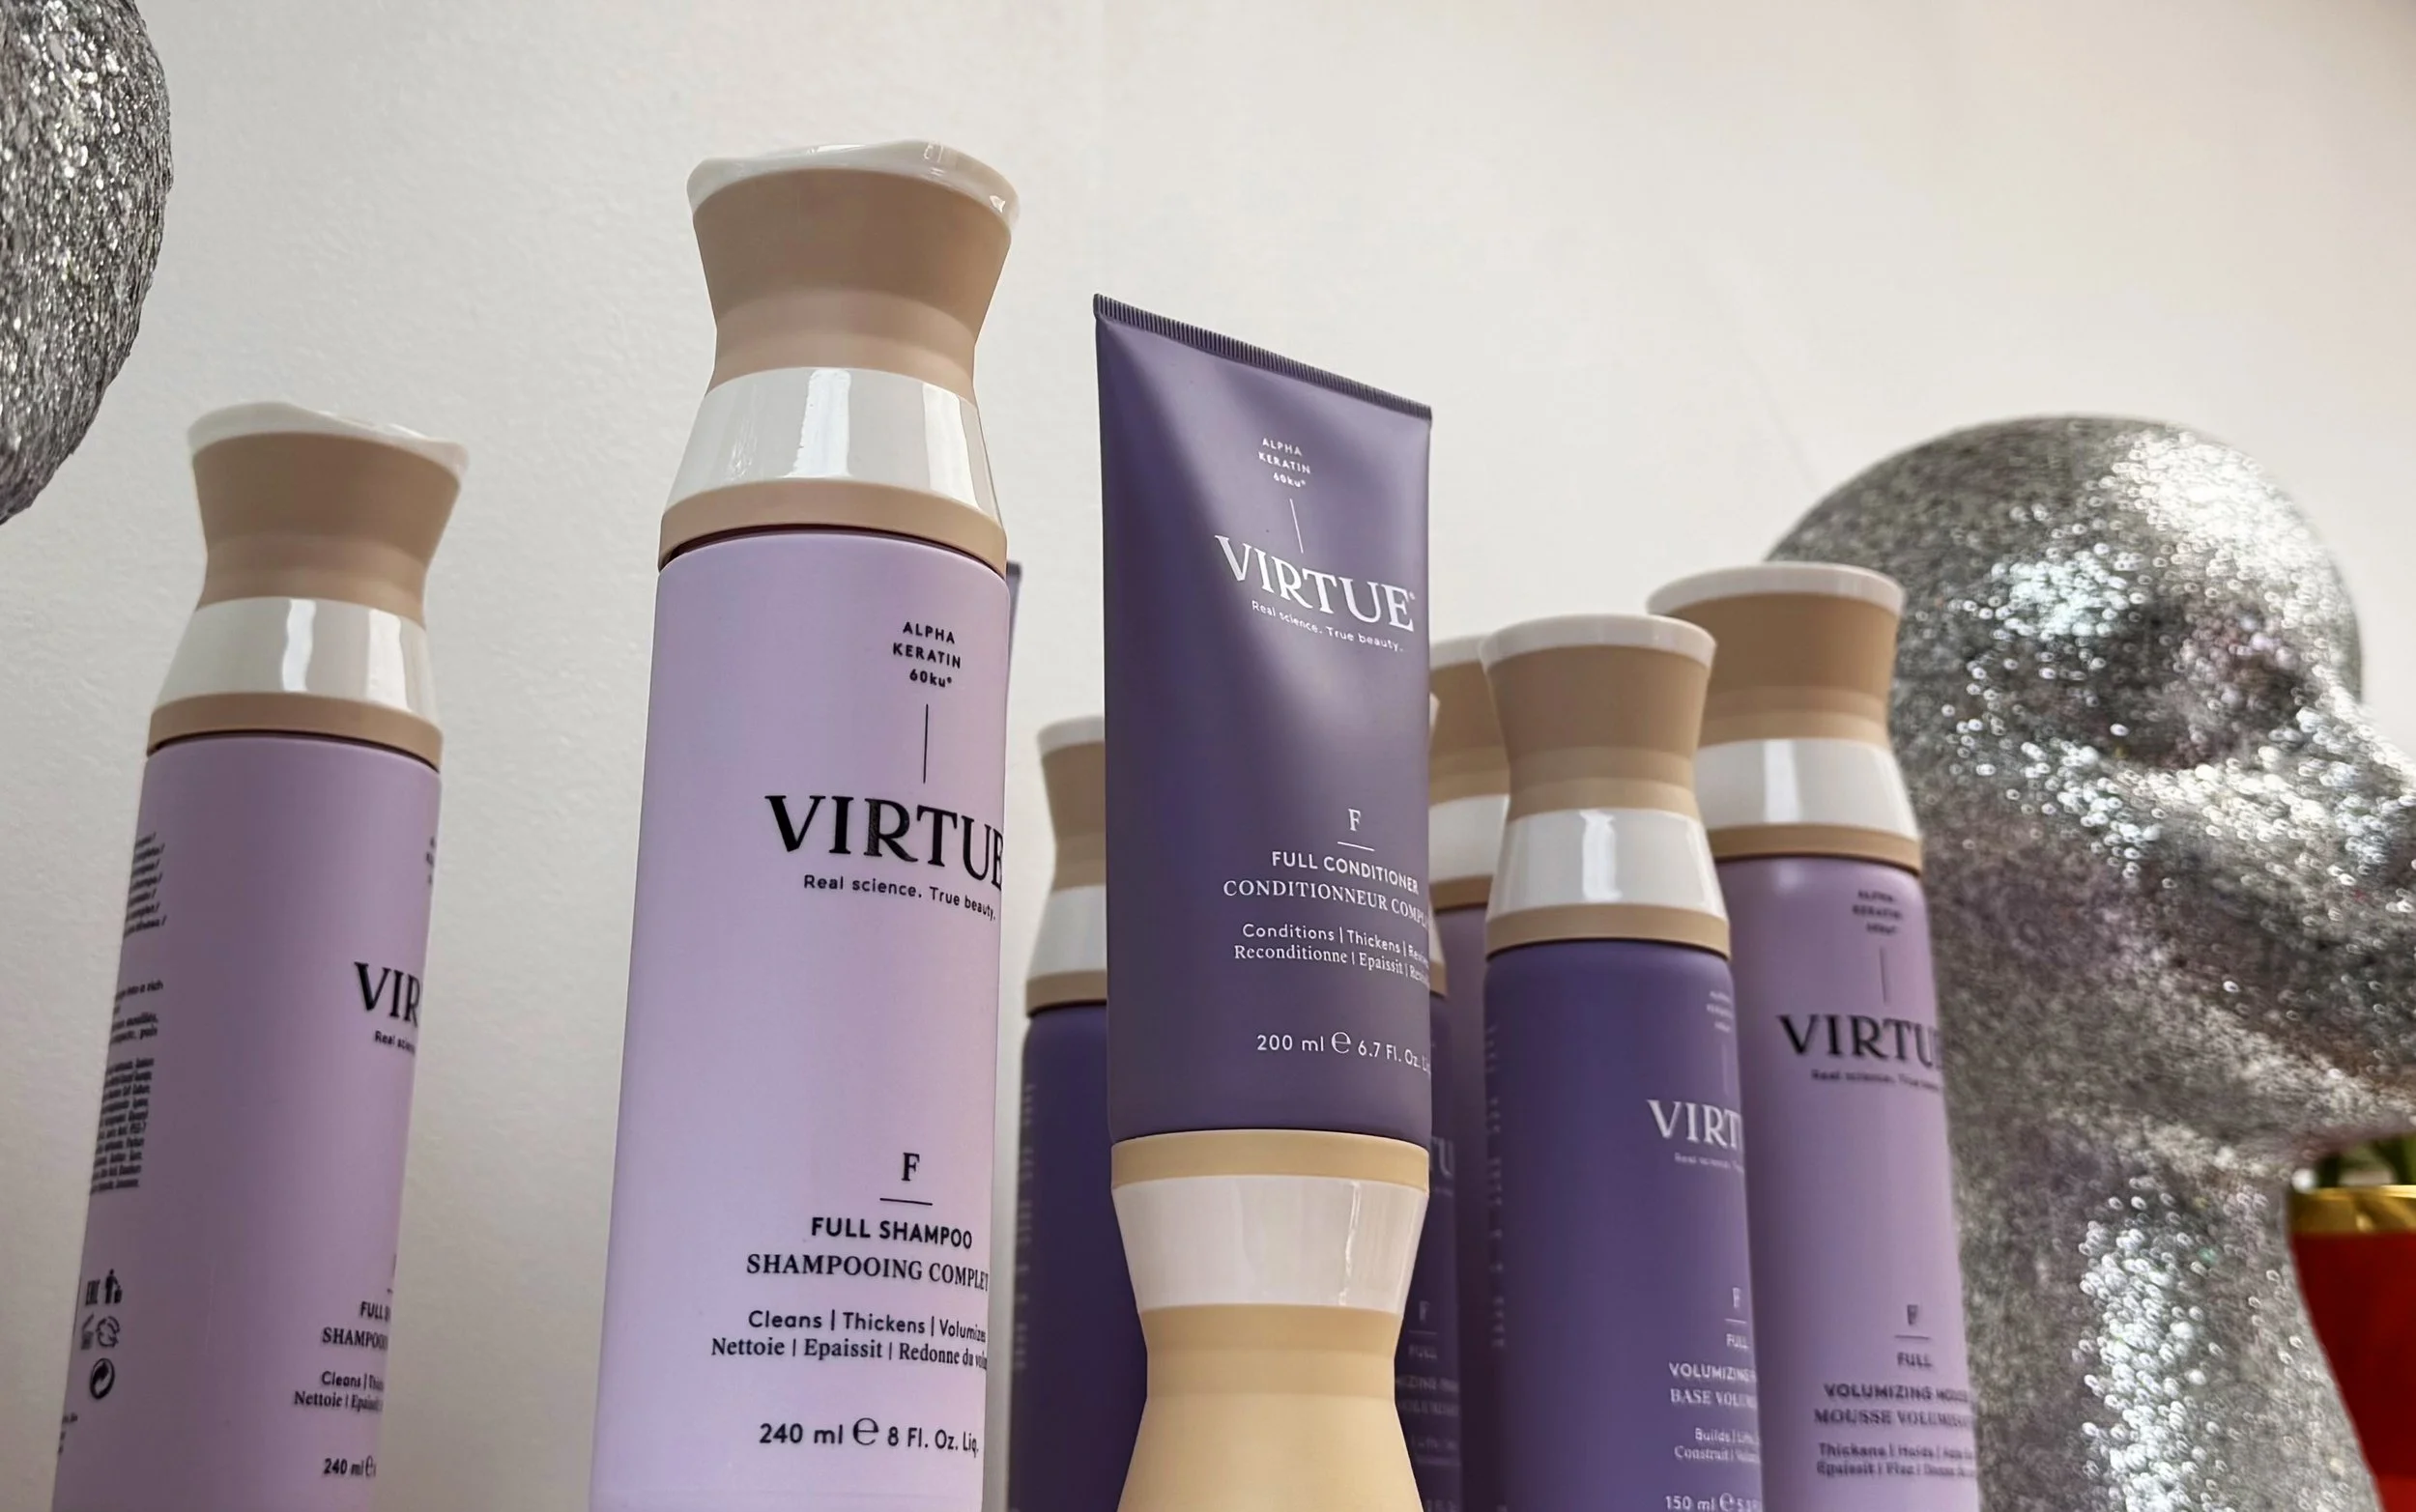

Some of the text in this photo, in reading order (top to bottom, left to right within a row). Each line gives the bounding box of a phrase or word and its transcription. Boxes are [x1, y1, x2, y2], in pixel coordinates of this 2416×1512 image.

[1262, 438, 1303, 457] ALPHA
[1257, 451, 1311, 474] KERATIN
[903, 621, 956, 644] ALPHA
[1251, 600, 1404, 653] Real science. True beauty.
[892, 642, 962, 669] KERATIN
[1347, 808, 1362, 832] F
[1272, 850, 1420, 896] FULL CONDITIONER
[803, 874, 996, 922] Real science. True beauty.
[1222, 879, 1428, 930] CONDITIONNEUR COMPL
[1242, 924, 1335, 942] Conditions
[1346, 929, 1401, 954] Thickens
[1234, 945, 1404, 977] Reconditionne Epaissit
[1256, 1035, 1293, 1051] 200
[1302, 1037, 1324, 1052] ml
[1358, 1040, 1381, 1058] 6.7
[1386, 1043, 1401, 1063] Fl.
[1777, 1014, 1943, 1070] VIRTU
[901, 1152, 921, 1182] F
[811, 1216, 973, 1249] FULL SHAMPOO
[746, 1254, 923, 1280] SHAMPOOING
[748, 1310, 822, 1328] Cleans
[843, 1312, 926, 1334] Thickens
[711, 1337, 786, 1356] Nettoie
[804, 1338, 882, 1362] Epaissit
[899, 1342, 961, 1365] Redonne
[322, 1369, 361, 1388] Cleans
[294, 1390, 343, 1409] Nettoie
[1670, 1388, 1712, 1405] BASE
[1823, 1383, 1933, 1401] VOLUMIZING
[1814, 1409, 1892, 1425] MOUSSE
[759, 1423, 804, 1444] 240
[814, 1425, 843, 1444] ml
[887, 1426, 900, 1446] 8
[907, 1427, 929, 1449] Fl.
[935, 1430, 959, 1451] Oz.
[963, 1432, 979, 1457] Liq.
[323, 1458, 348, 1476] 240
[1665, 1495, 1693, 1510] 150
[1697, 1498, 1716, 1512] ml
